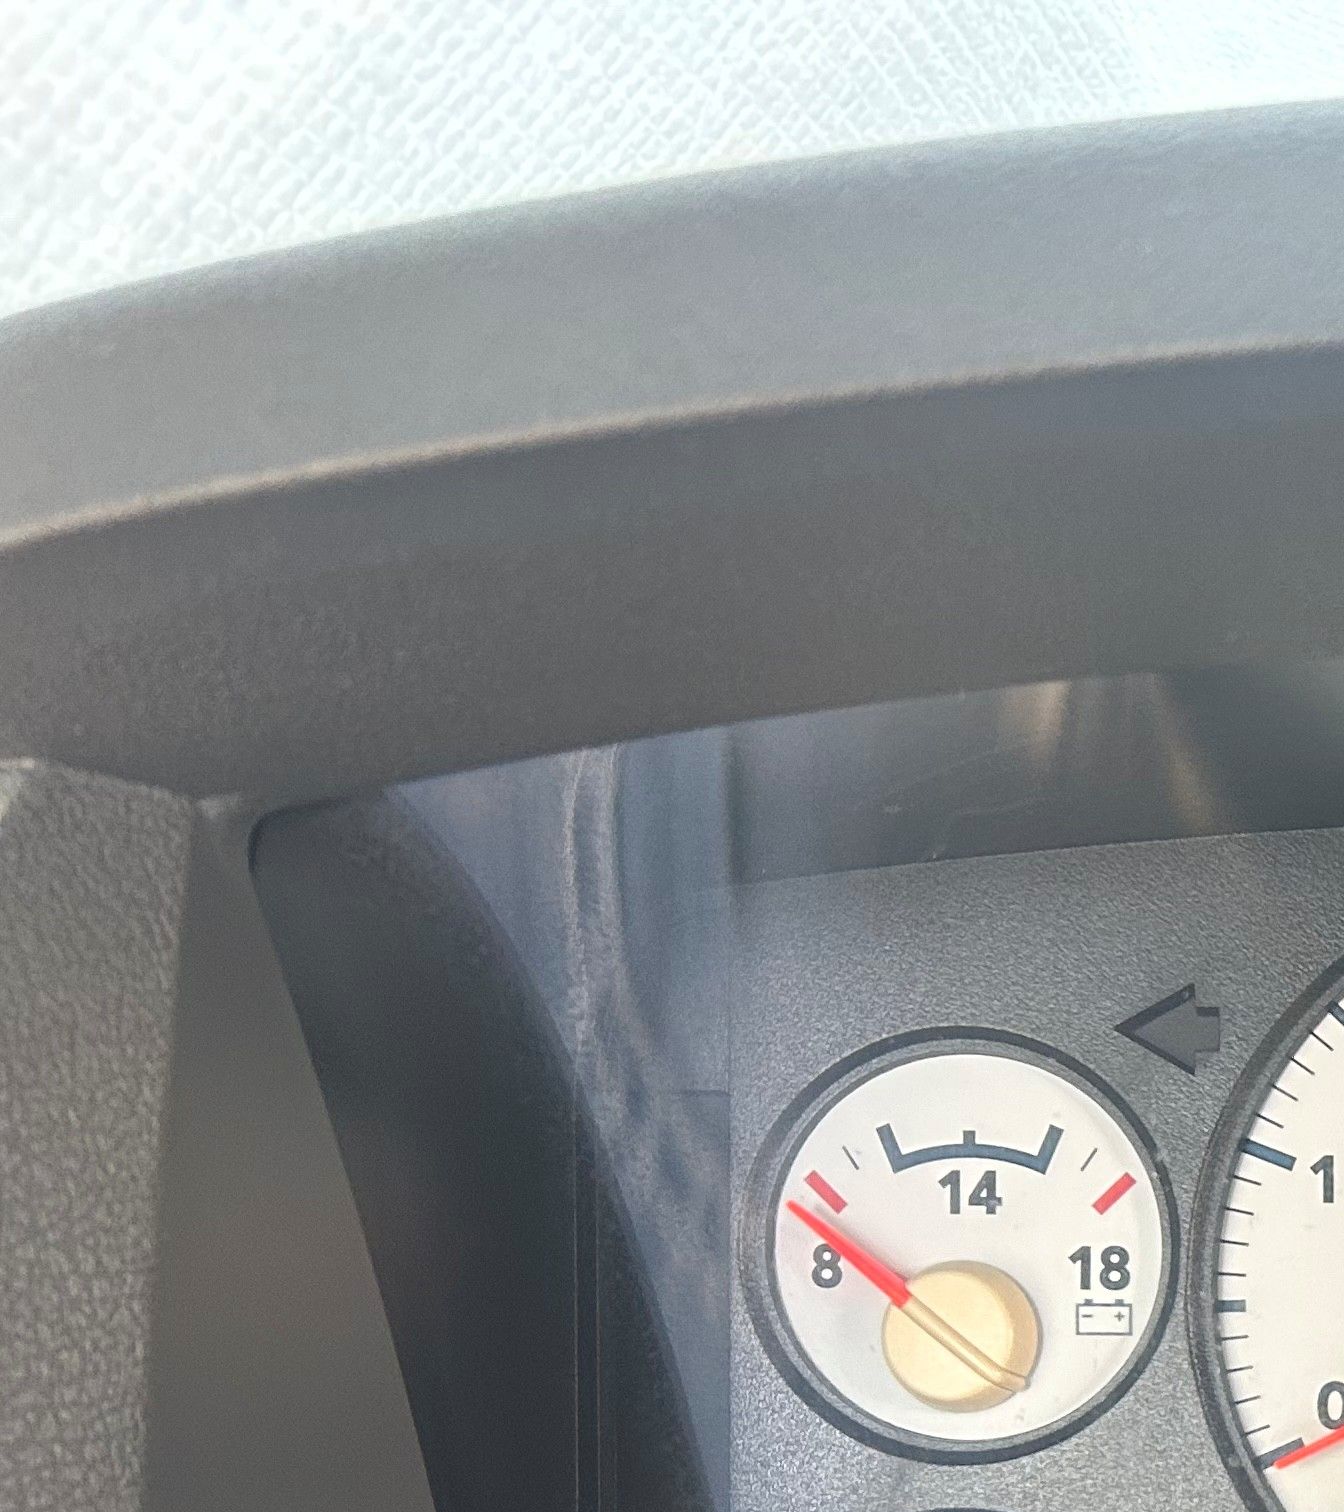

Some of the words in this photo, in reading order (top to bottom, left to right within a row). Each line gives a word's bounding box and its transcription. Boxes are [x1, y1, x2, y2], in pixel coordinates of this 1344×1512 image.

[938, 1170, 1002, 1215] 14
[1310, 1155, 1334, 1203] 1
[812, 1244, 842, 1288] 8
[1068, 1246, 1130, 1290] 18
